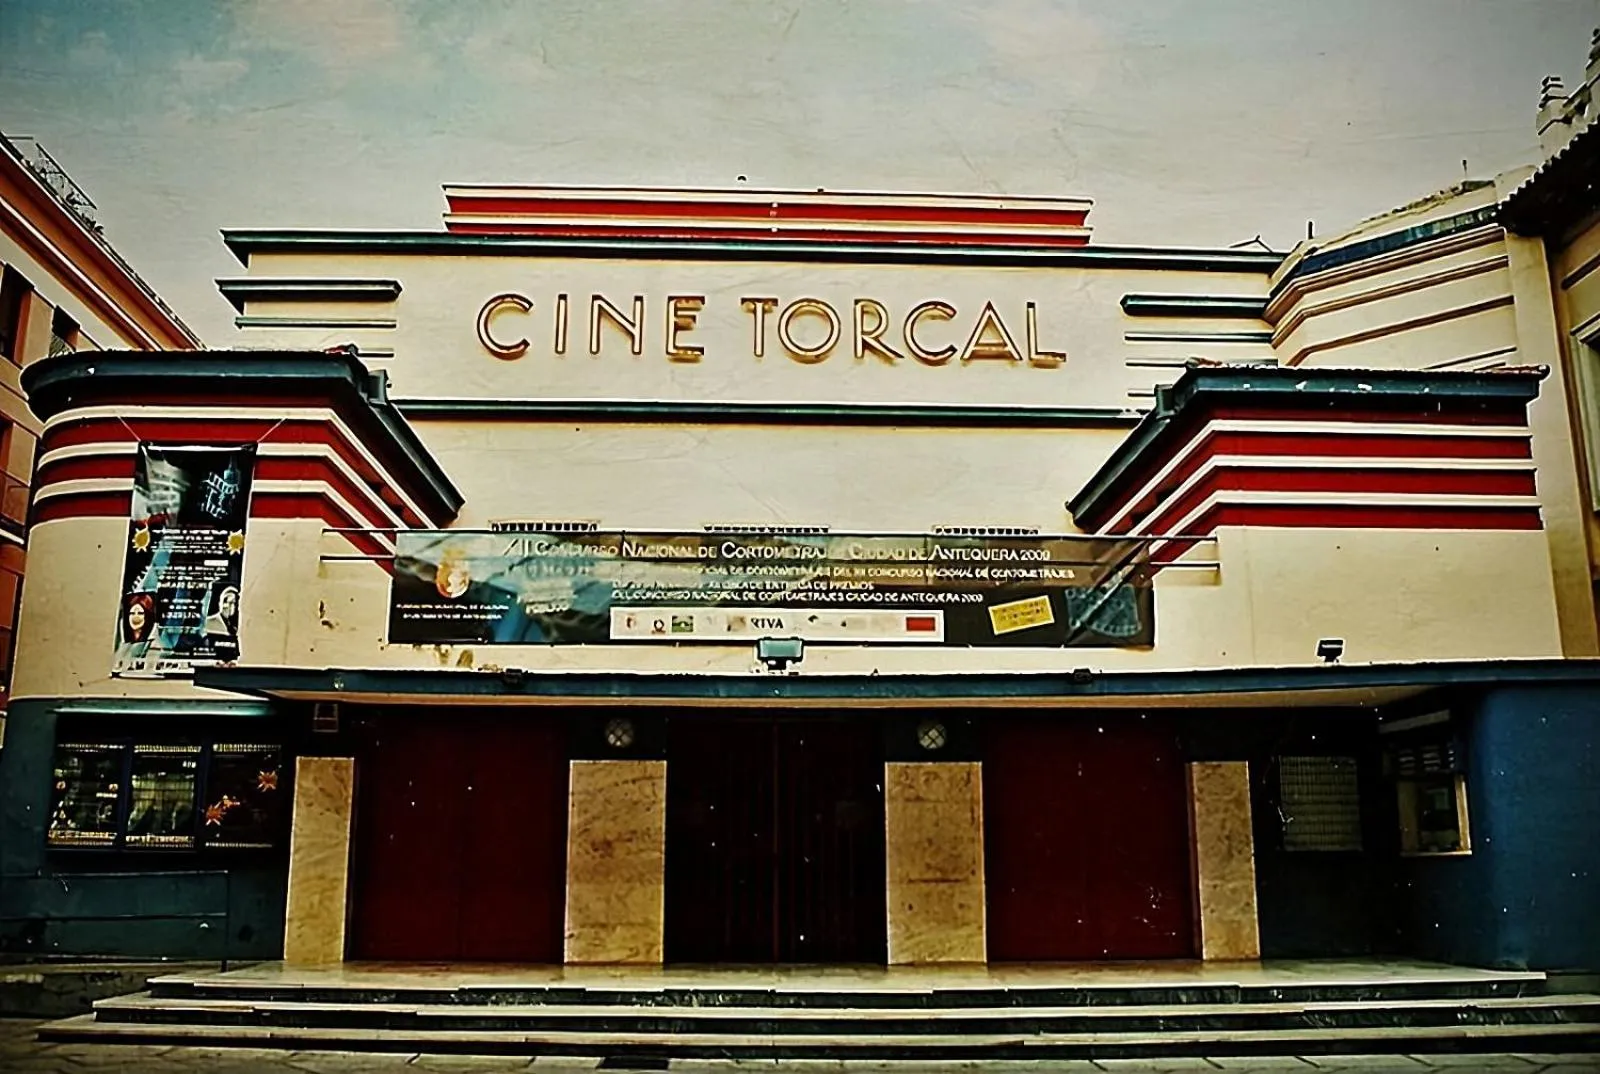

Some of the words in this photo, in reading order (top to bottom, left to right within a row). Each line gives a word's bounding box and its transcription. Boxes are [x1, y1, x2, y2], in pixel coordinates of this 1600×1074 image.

[477, 293, 704, 360] CINE
[741, 297, 1066, 367] TORCAL
[622, 541, 697, 558] NACIONAL
[698, 546, 718, 558] DE
[927, 544, 1020, 561] ANTEQUERA
